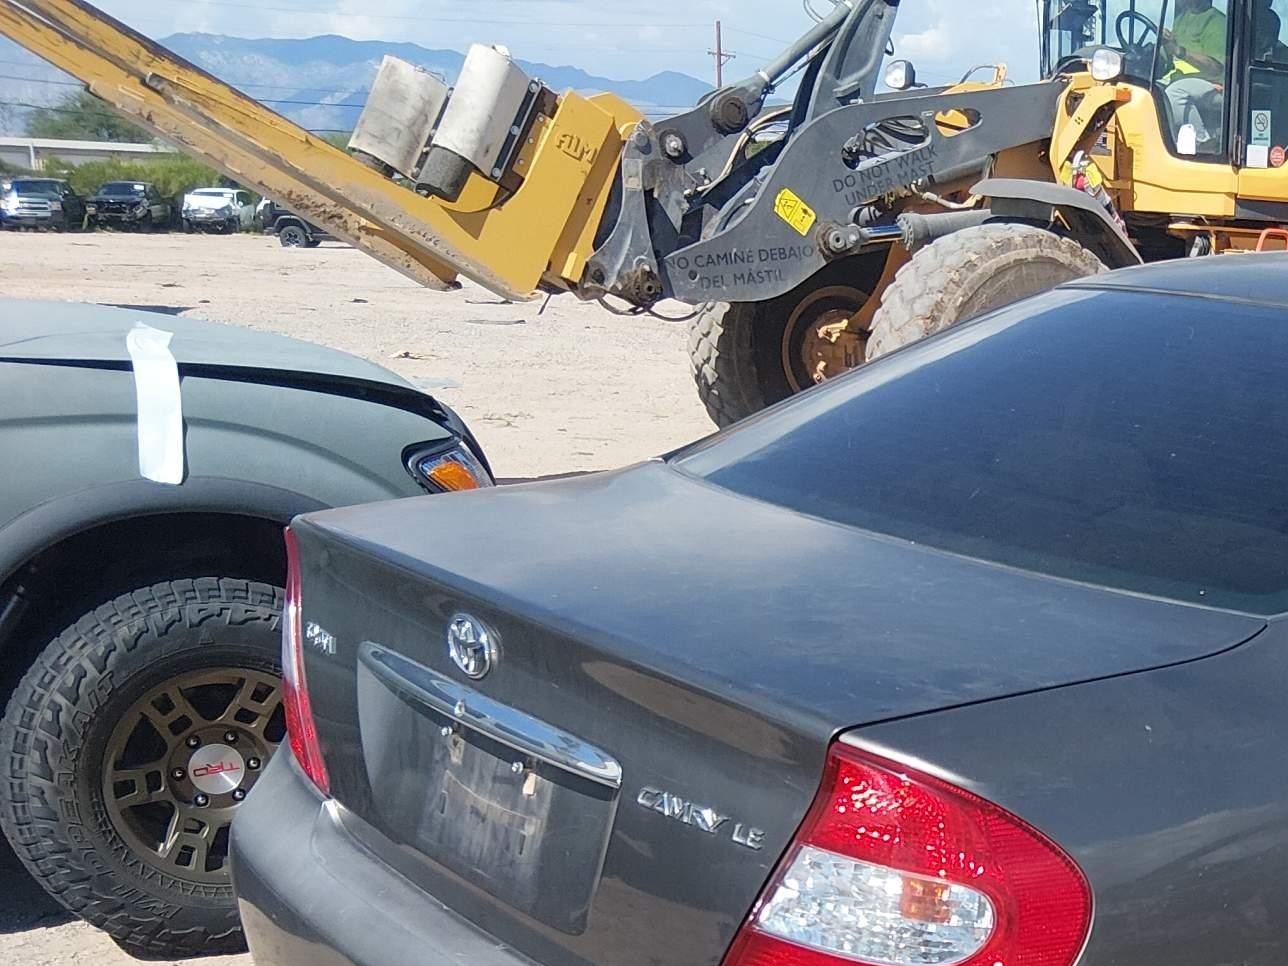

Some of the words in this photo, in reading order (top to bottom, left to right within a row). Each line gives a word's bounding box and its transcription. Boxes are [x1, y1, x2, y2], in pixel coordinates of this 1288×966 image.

[833, 176, 855, 193] DO
[860, 165, 891, 184] NOT
[896, 146, 939, 172] WALK
[845, 180, 896, 204] UNDER
[902, 160, 936, 184] MAST
[694, 249, 755, 269] CAMINE
[700, 275, 731, 290] DEL
[193, 761, 241, 778] TRD
[636, 785, 731, 836] CAMRY
[731, 822, 766, 852] LE
